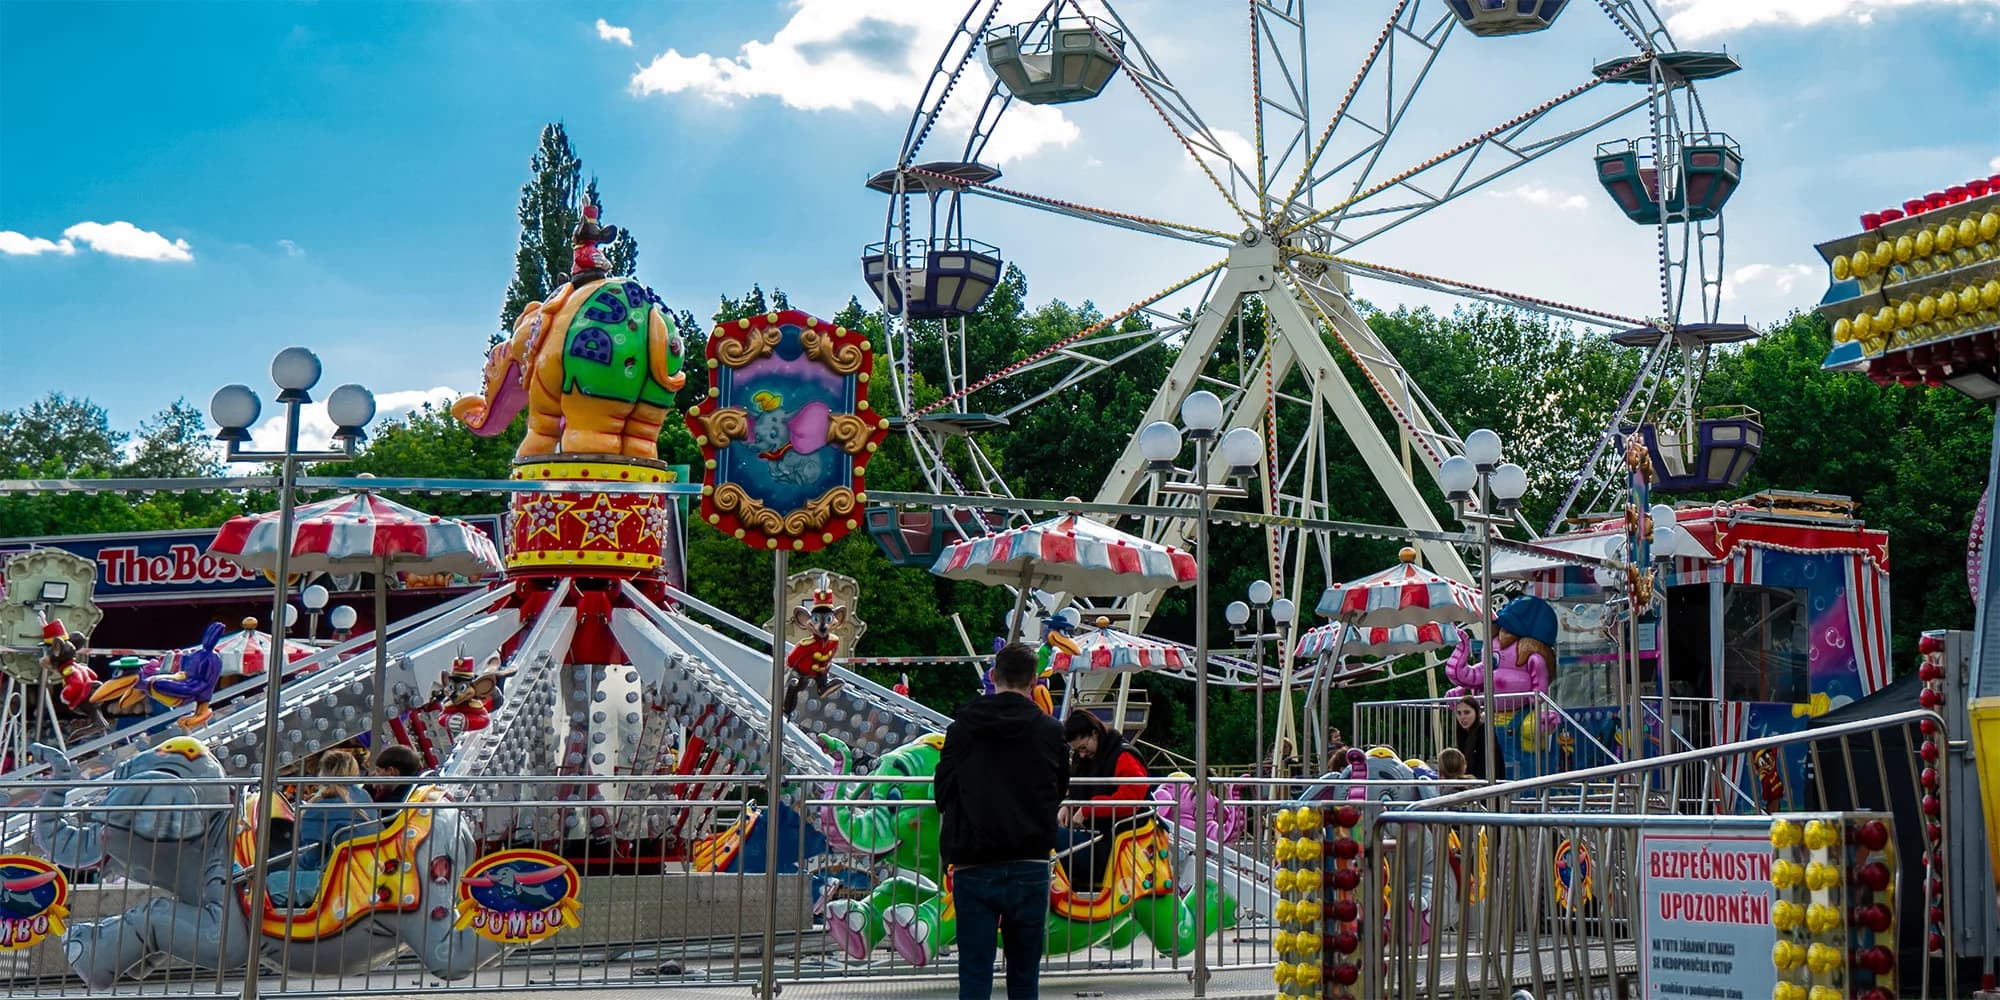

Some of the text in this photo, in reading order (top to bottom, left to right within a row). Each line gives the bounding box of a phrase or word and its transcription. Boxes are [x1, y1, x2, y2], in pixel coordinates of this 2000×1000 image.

[1650, 846, 1773, 882] BEZPEČNOSTN
[473, 907, 562, 939] JUMBO
[1660, 890, 1769, 925] UPOZORNĚNÍ
[0, 914, 49, 947] MBO
[1652, 955, 1661, 969] SE
[1711, 960, 1733, 975] VSTUP
